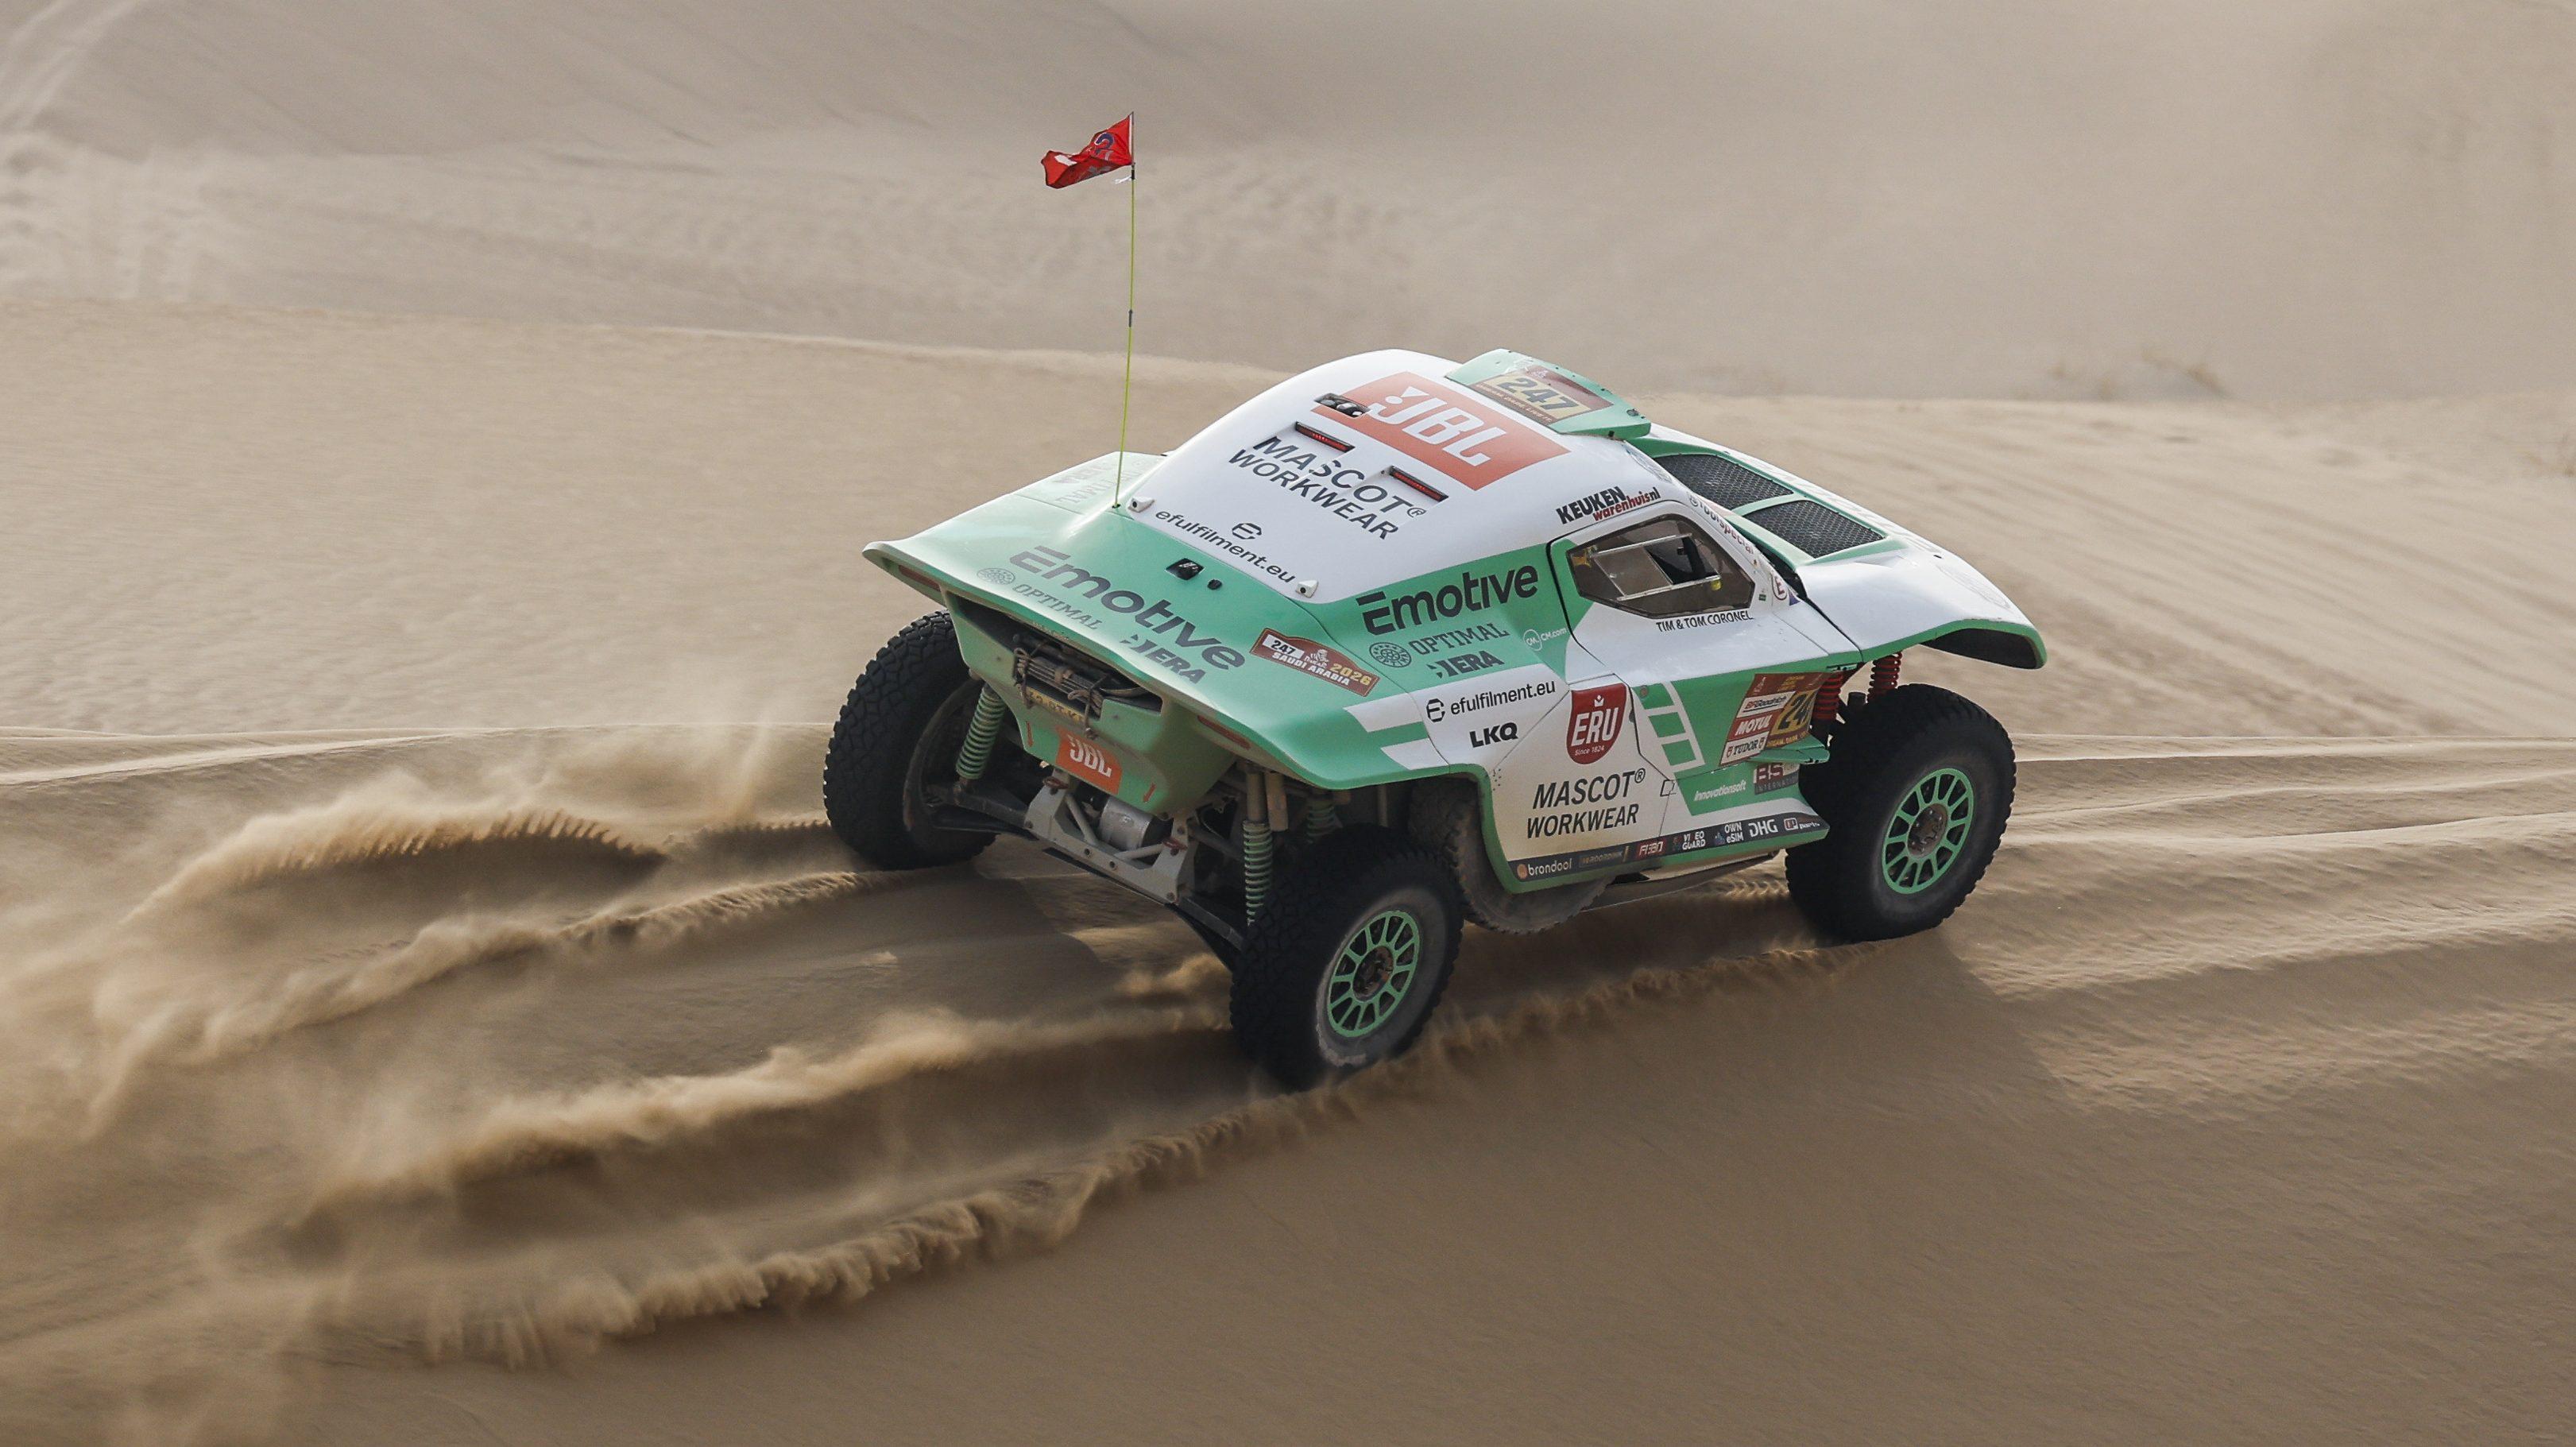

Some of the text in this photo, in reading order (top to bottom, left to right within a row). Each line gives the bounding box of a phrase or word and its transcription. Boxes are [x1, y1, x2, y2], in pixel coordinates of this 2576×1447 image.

[1497, 377, 1580, 411] 247
[1369, 396, 1507, 467] JBL
[1228, 449, 1398, 540] WORKWEAR
[1556, 486, 1626, 524] KEUKEN
[1155, 511, 1297, 583] efulfilment.eu
[1010, 545, 1246, 671] Emotive
[1012, 583, 1103, 630] OPTIMAL
[1356, 565, 1539, 636] Emotive
[1541, 628, 1567, 641] CM.com
[1655, 610, 1754, 633] TIM & TOM CORONEL
[1271, 640, 1296, 656] 247
[1408, 623, 1511, 656] OPTIMAL
[1271, 652, 1351, 687] SAUDI ARABIA
[1329, 663, 1373, 687] 2026
[1450, 681, 1556, 715] efulfilment.eu
[1777, 692, 1808, 730] 24
[1470, 722, 1519, 749] LKQ
[1571, 706, 1619, 747] ERU
[1735, 714, 1773, 737] MOTUL
[1733, 739, 1758, 756] TUDOR
[1526, 803, 1639, 839] WORKWEAR
[1683, 830, 1704, 842] VIEO
[1724, 822, 1742, 834] OWN
[1748, 818, 1778, 838] DHG
[1682, 839, 1706, 850] GUARD
[1726, 832, 1744, 844] eSIM
[1528, 858, 1572, 876] brondool
